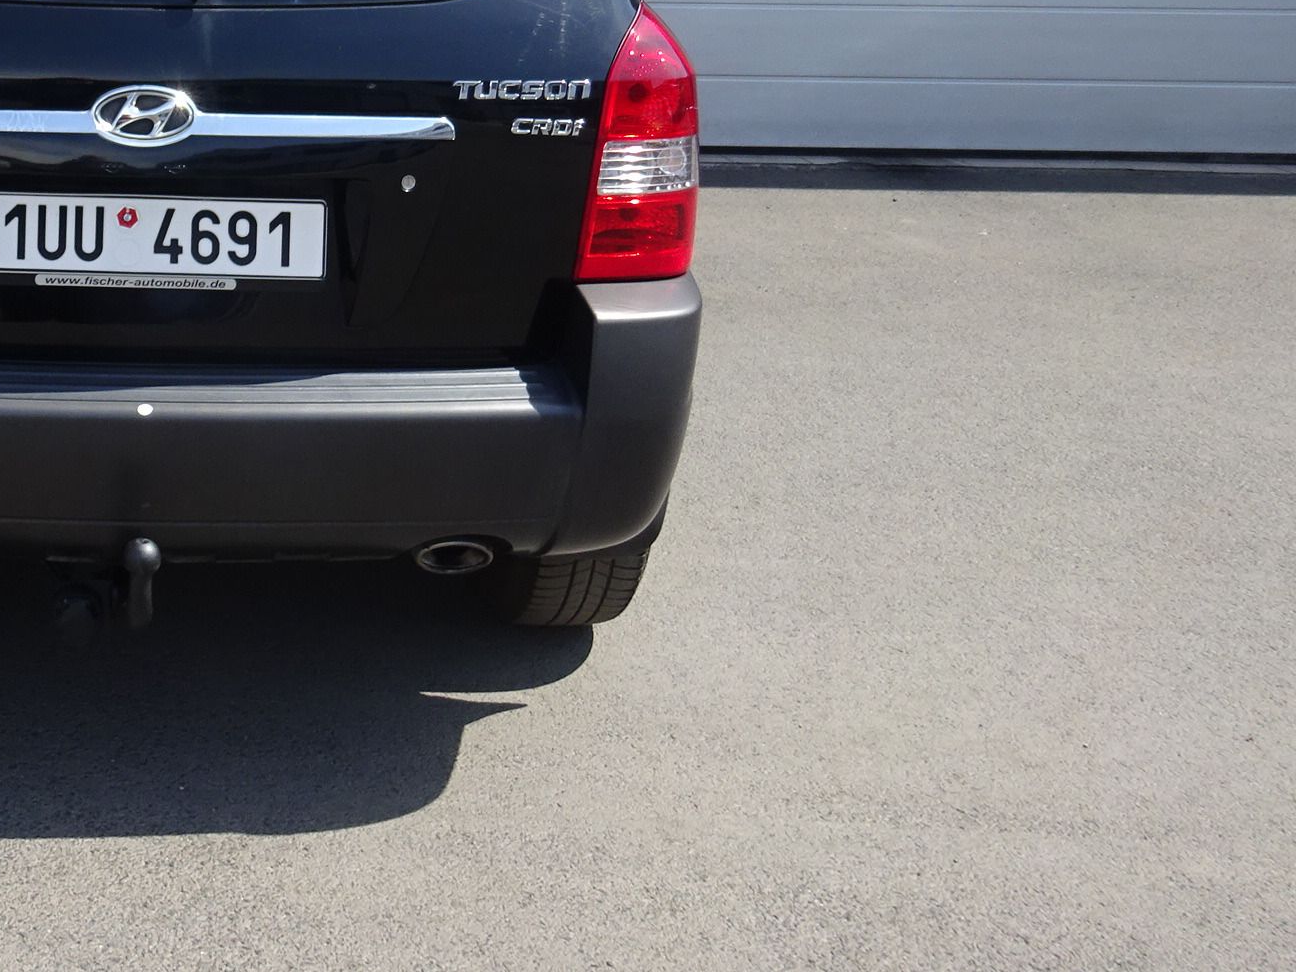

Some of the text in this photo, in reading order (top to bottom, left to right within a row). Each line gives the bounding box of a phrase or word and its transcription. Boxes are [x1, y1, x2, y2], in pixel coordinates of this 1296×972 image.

[453, 78, 592, 101] TUCSON
[4, 204, 292, 268] 1UU 4691
[45, 276, 227, 290] www.fischer-automobile.de
